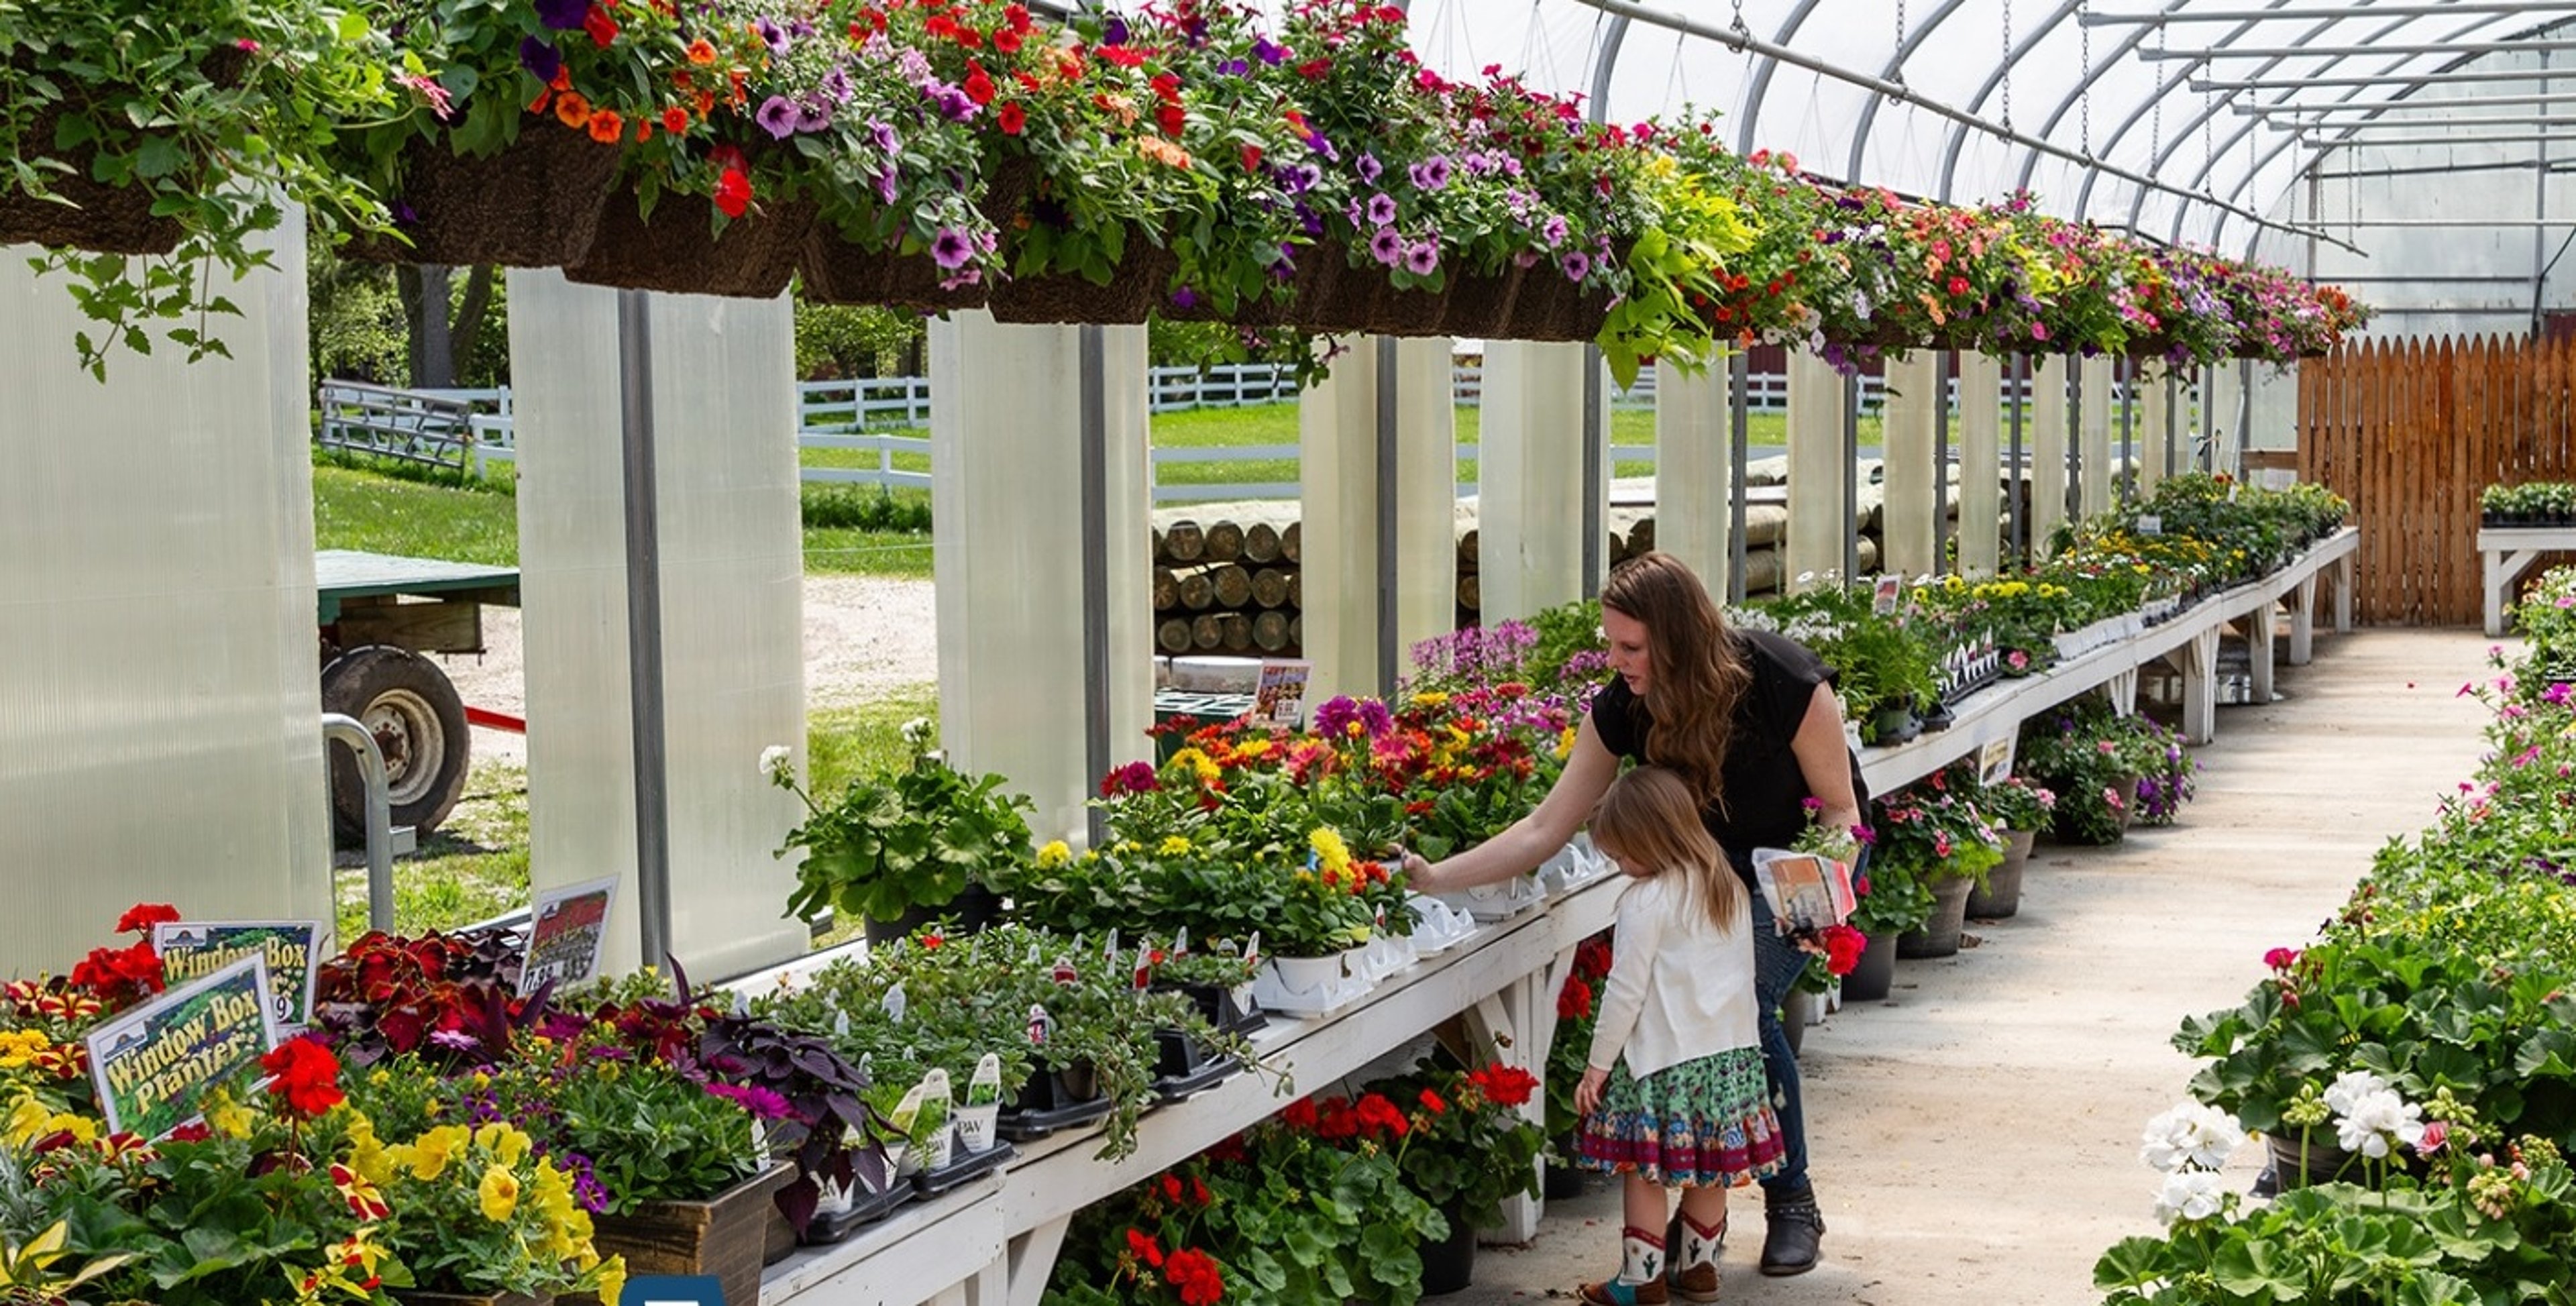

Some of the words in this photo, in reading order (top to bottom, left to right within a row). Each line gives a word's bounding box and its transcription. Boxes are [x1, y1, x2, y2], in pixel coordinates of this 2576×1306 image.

[266, 936, 307, 968] Box
[107, 1008, 209, 1096] Window
[210, 989, 259, 1032] Box
[135, 1035, 242, 1115] Planter
